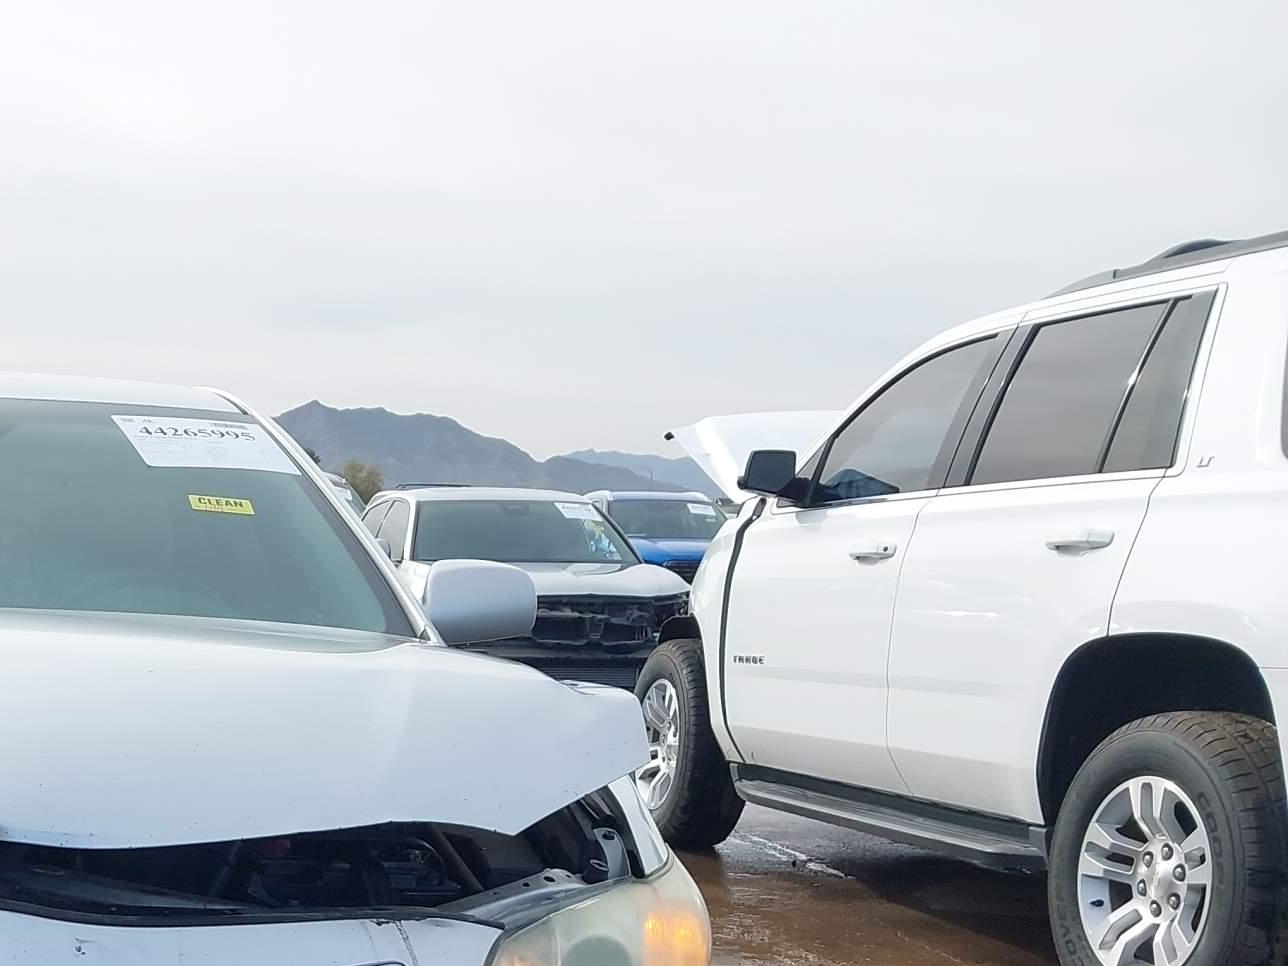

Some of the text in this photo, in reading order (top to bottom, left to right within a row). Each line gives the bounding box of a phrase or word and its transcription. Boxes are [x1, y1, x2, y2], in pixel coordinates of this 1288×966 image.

[138, 425, 257, 442] 44265995
[1195, 456, 1215, 468] LT
[197, 496, 244, 509] CLEAN
